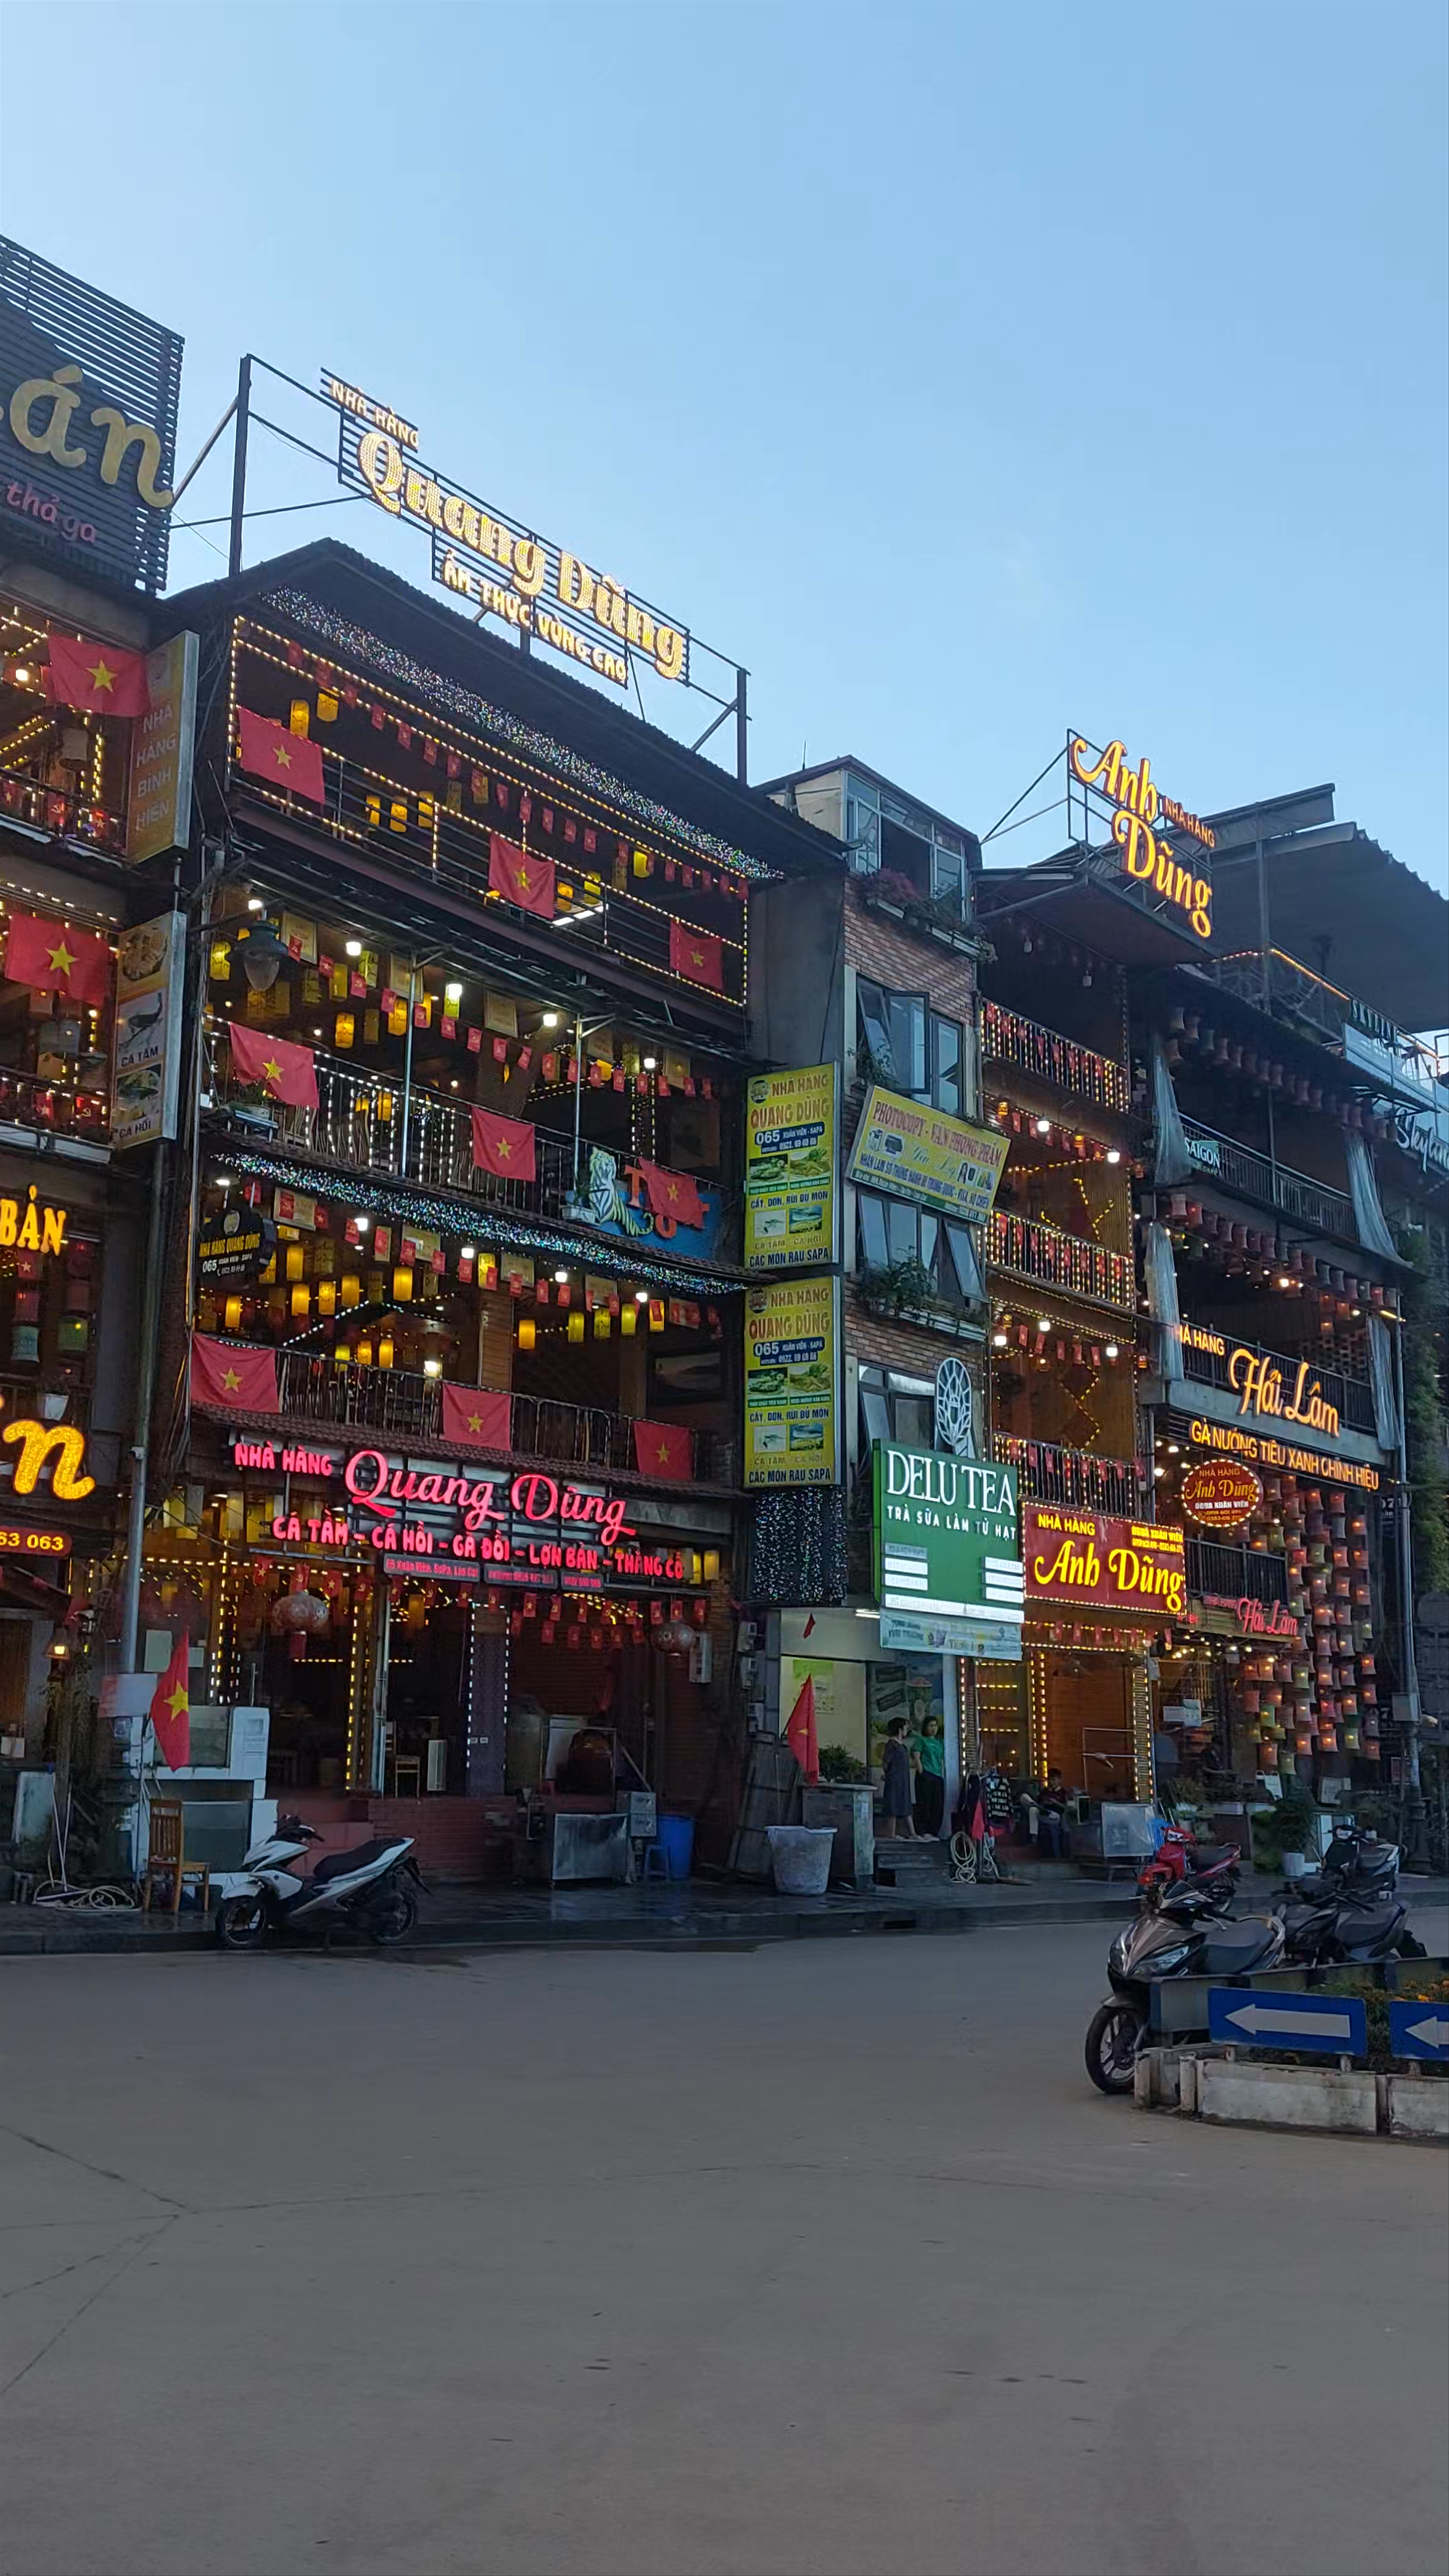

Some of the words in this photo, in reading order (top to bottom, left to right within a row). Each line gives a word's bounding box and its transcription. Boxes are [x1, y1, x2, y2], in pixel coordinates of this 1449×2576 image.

[0, 364, 174, 508] án
[374, 405, 419, 448] HÀNG
[357, 431, 546, 595] Quang
[60, 515, 97, 546] ga
[590, 649, 627, 681] CAO
[1071, 738, 1158, 823] Anh
[751, 1103, 793, 1129] QUANG
[756, 1130, 780, 1144] 065
[1184, 1137, 1220, 1170] SAIGON
[202, 1259, 217, 1273] 065
[789, 1249, 806, 1264] RAU
[807, 1247, 829, 1261] SAPA
[749, 1315, 792, 1340] QUANG
[1194, 1328, 1225, 1356] HÀNG
[755, 1342, 779, 1356] 065
[1229, 1348, 1283, 1416] Hải
[1284, 1362, 1340, 1438] Lâm
[1191, 1417, 1211, 1446] GÀ
[1260, 1439, 1285, 1466] TIÊU
[1289, 1449, 1319, 1476] XANH
[1355, 1464, 1379, 1492] HIỆU
[789, 1470, 805, 1481] RAU
[808, 1468, 830, 1481] SAPA
[1185, 1480, 1215, 1499] Anh
[235, 1440, 275, 1470] NHÀ
[282, 1445, 333, 1476] HÀNG
[345, 1450, 505, 1531] Quang
[511, 1474, 636, 1546] Dũng
[272, 1510, 301, 1542] CÁ
[371, 1522, 397, 1551] CÁ
[452, 1530, 476, 1558] GÀ
[887, 1503, 910, 1522] TRÀ
[946, 1513, 969, 1532] LÀM
[995, 1525, 1017, 1541] HẠT
[1038, 1513, 1062, 1530] NHÀ
[1064, 1517, 1095, 1536] HÀNG
[27, 1534, 64, 1551] 063
[1035, 1539, 1100, 1587] Anh
[1108, 1549, 1185, 1612] Dũng
[1266, 1599, 1298, 1636] Lâm
